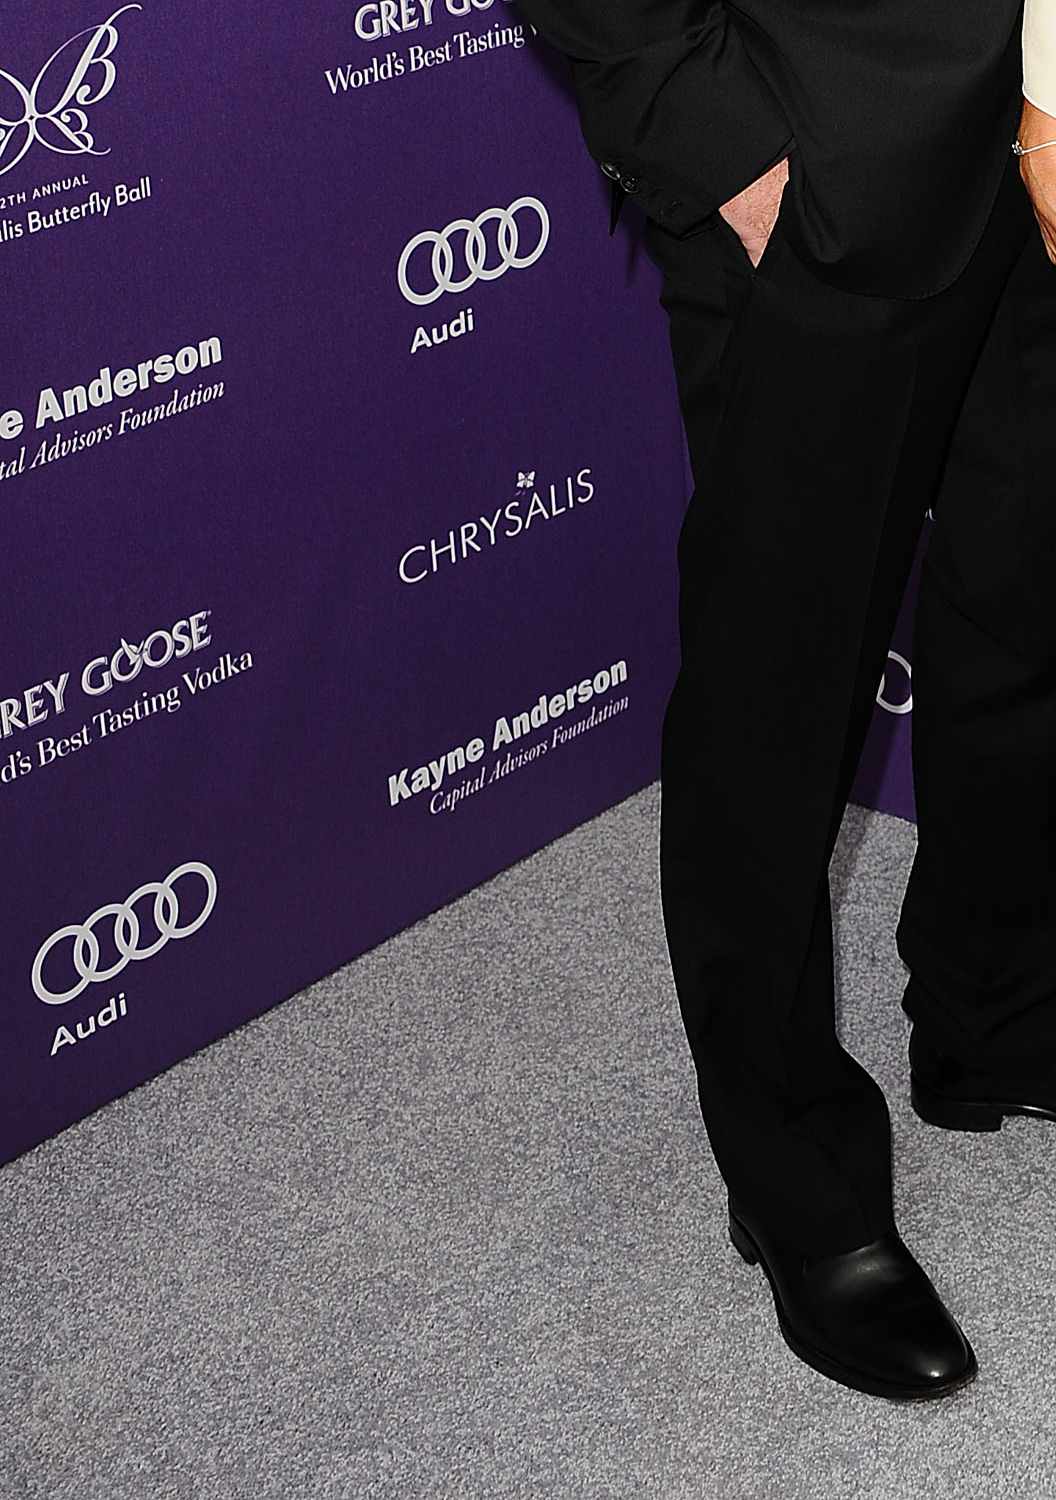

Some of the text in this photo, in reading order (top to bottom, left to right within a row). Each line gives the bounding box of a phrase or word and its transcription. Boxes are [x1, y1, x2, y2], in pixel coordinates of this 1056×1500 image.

[324, 22, 525, 95] World's Best Tasting
[0, 174, 89, 210] 2TH ANNUAL
[27, 191, 111, 234] Butterfly
[114, 176, 152, 207] Ball
[410, 307, 474, 354] Audi
[29, 422, 113, 469] Advisors
[118, 381, 225, 436] Foundation
[35, 336, 224, 429] Anderson
[399, 468, 594, 583] CHRYSALIS
[0, 610, 212, 744] REY GOOSE
[37, 652, 254, 767] Best Tasting Vodka
[388, 660, 629, 806] Kayne Anderson
[429, 695, 630, 814] Capital Advisors Foundation
[50, 992, 127, 1056] Audi
